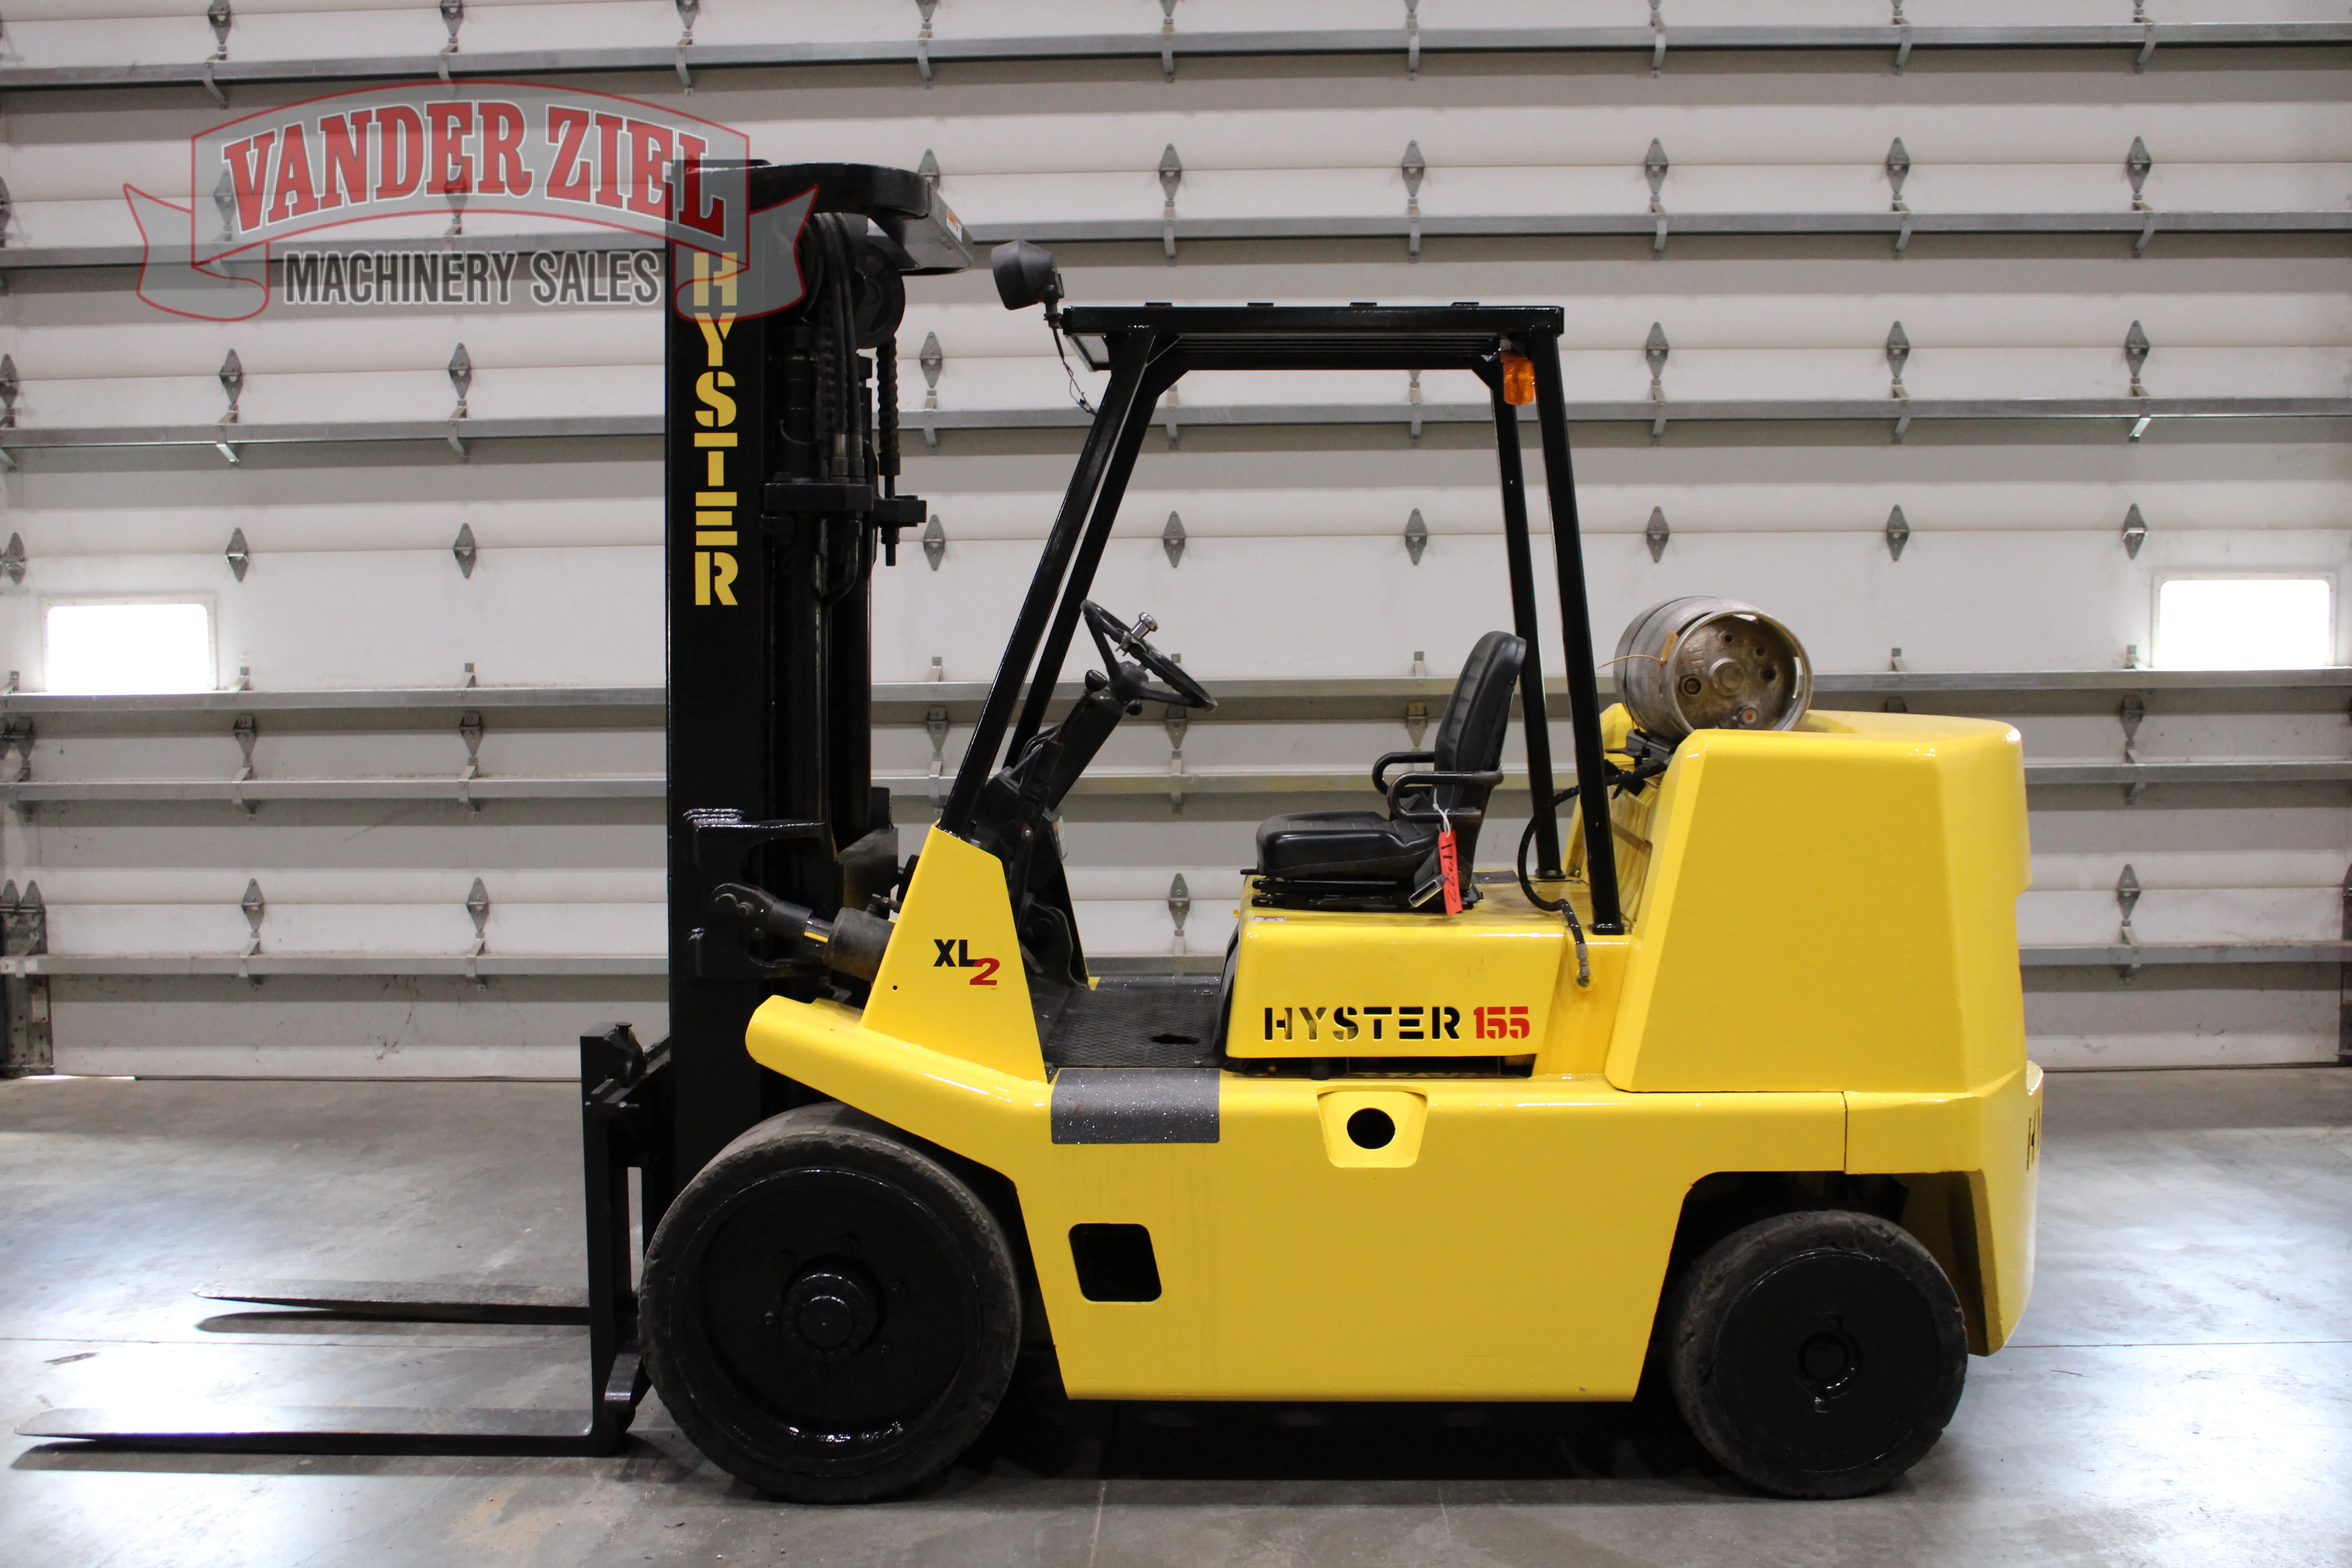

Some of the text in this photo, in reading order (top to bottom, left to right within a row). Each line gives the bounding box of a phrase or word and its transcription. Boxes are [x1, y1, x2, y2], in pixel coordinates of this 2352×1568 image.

[694, 252, 738, 605] HYSTER
[1264, 1006, 1530, 1041] HYSTER 155
